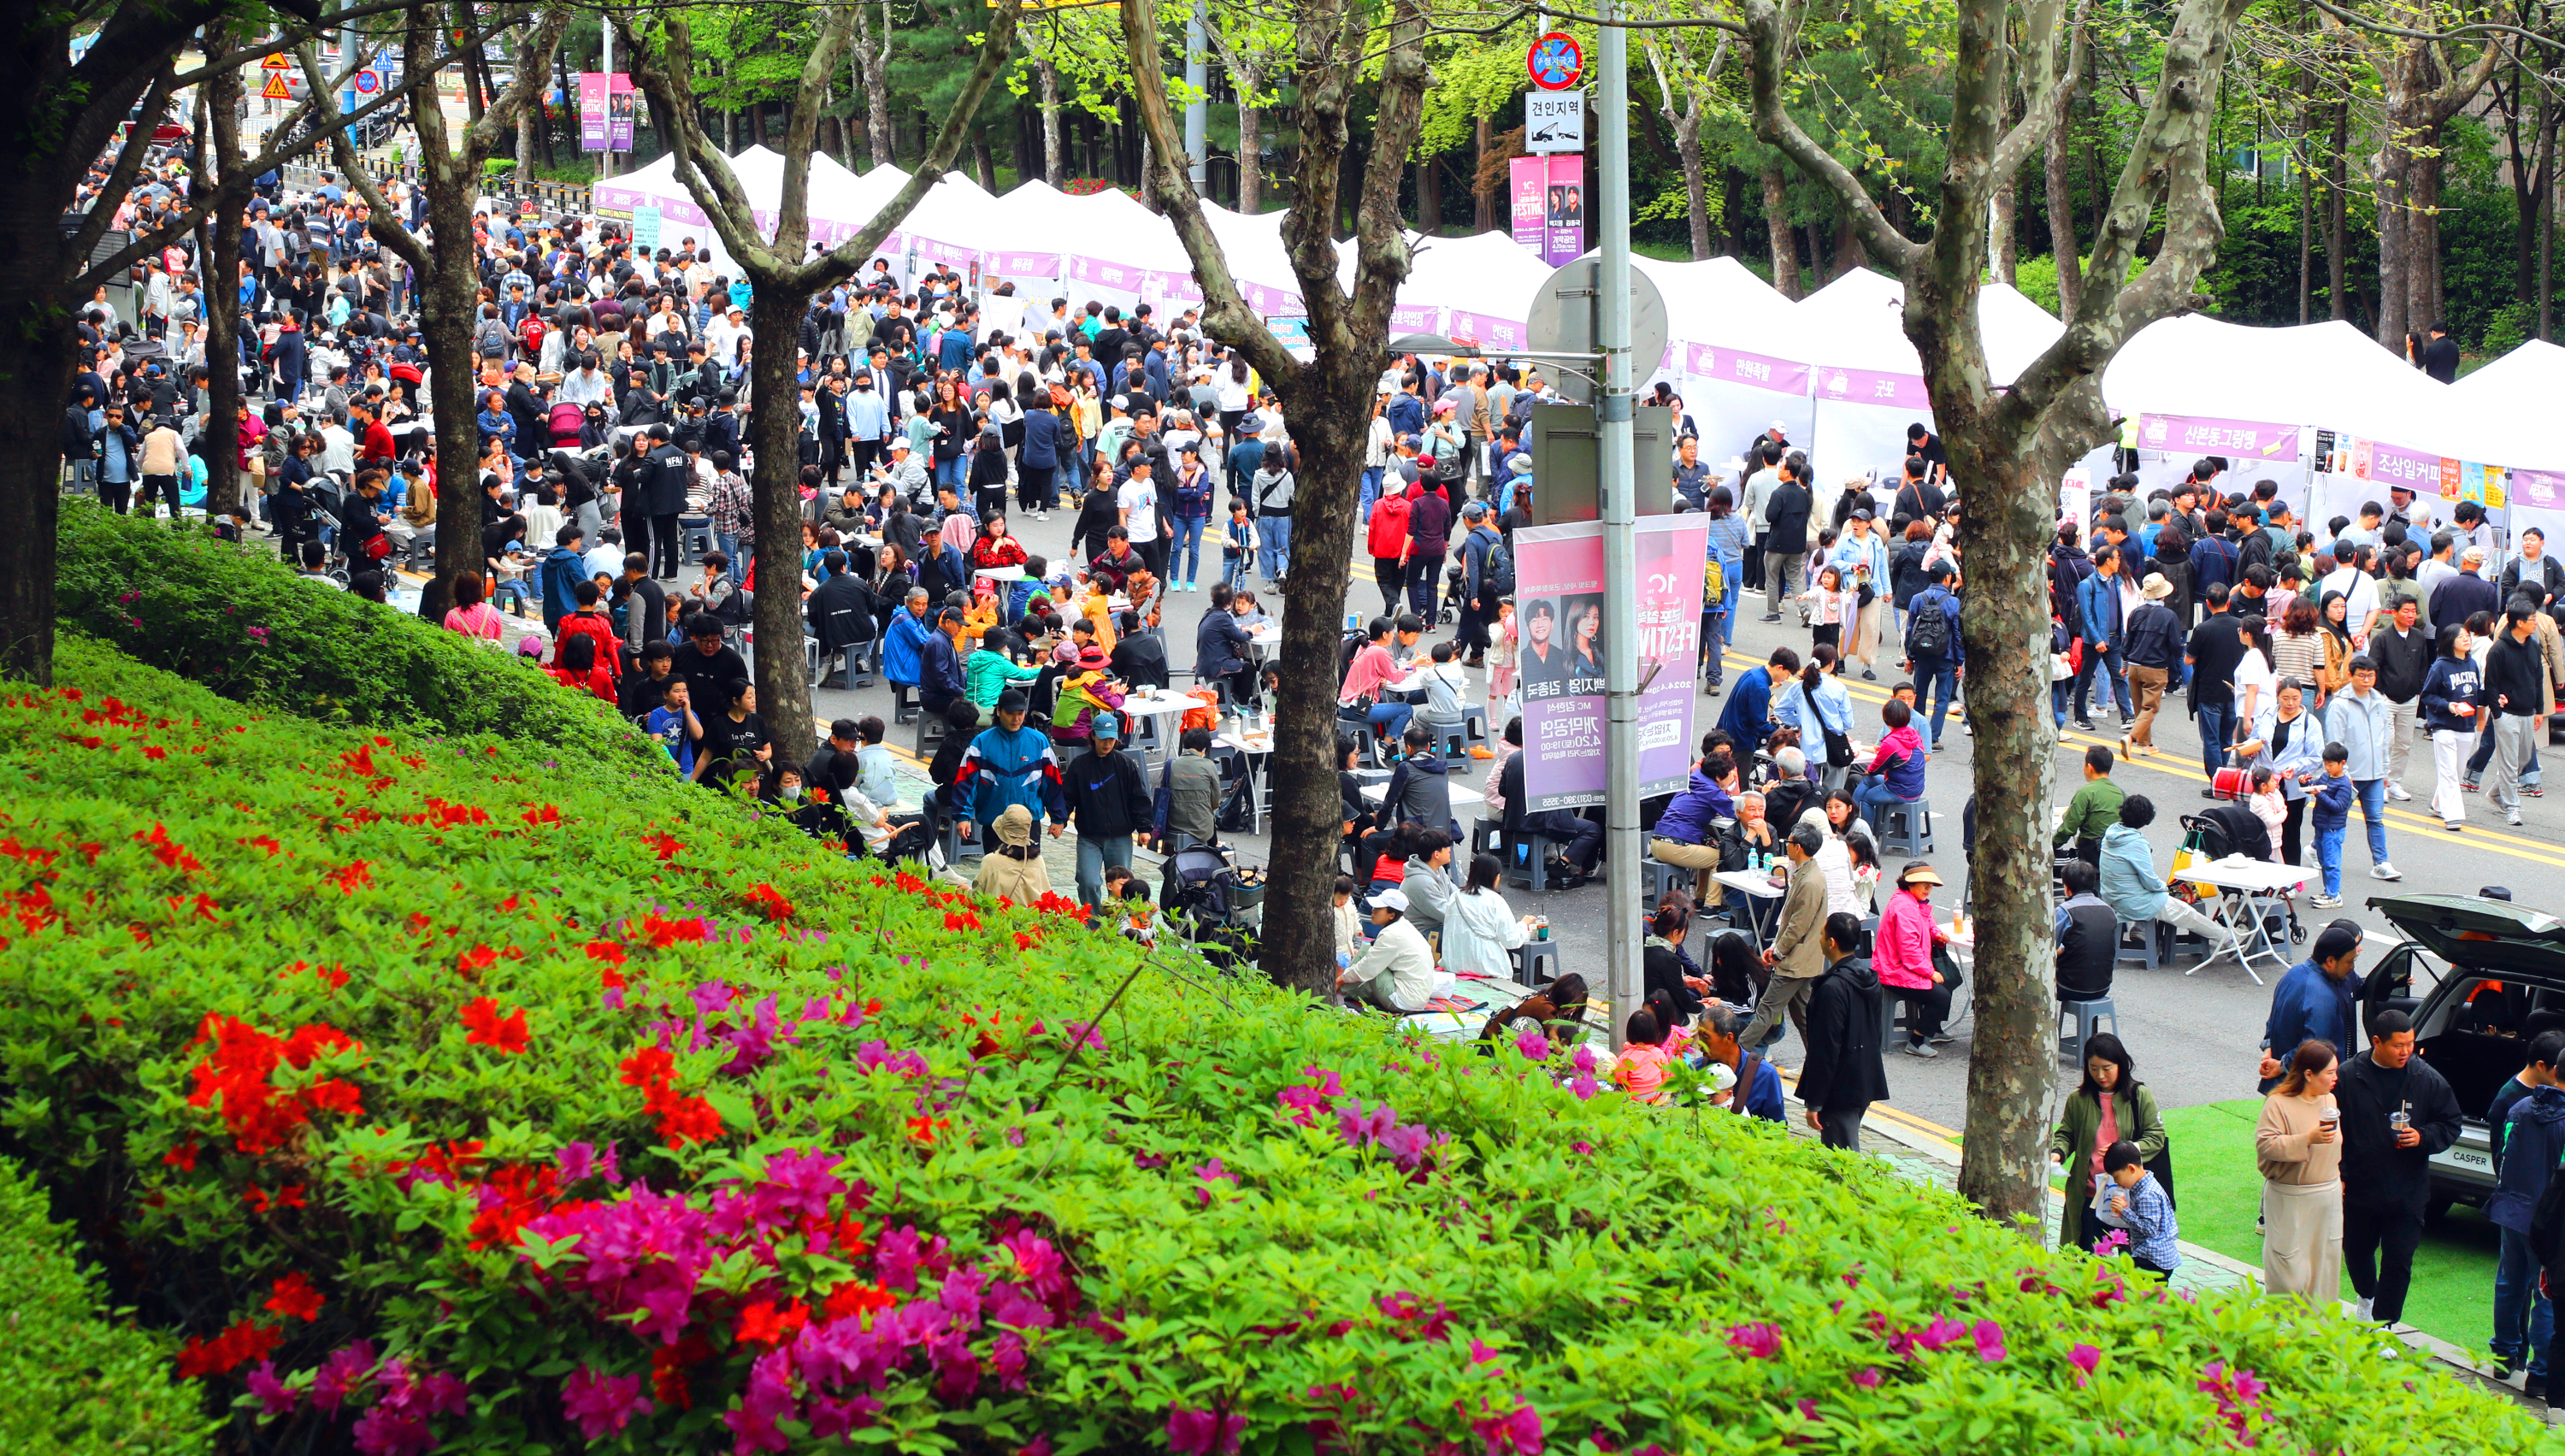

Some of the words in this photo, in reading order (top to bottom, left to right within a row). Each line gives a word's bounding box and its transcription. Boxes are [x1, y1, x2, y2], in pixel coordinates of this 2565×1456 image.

[1532, 100, 1578, 116] 견인지역
[1270, 323, 1293, 334] Enjoy
[1492, 324, 1515, 343] 언더독
[1274, 334, 1308, 346] nderdog
[1736, 358, 1771, 382] 만원족발
[2184, 425, 2258, 451] 산본동그랑땡
[2377, 453, 2441, 486] 조상일커피
[2453, 1152, 2487, 1166] CASPER
